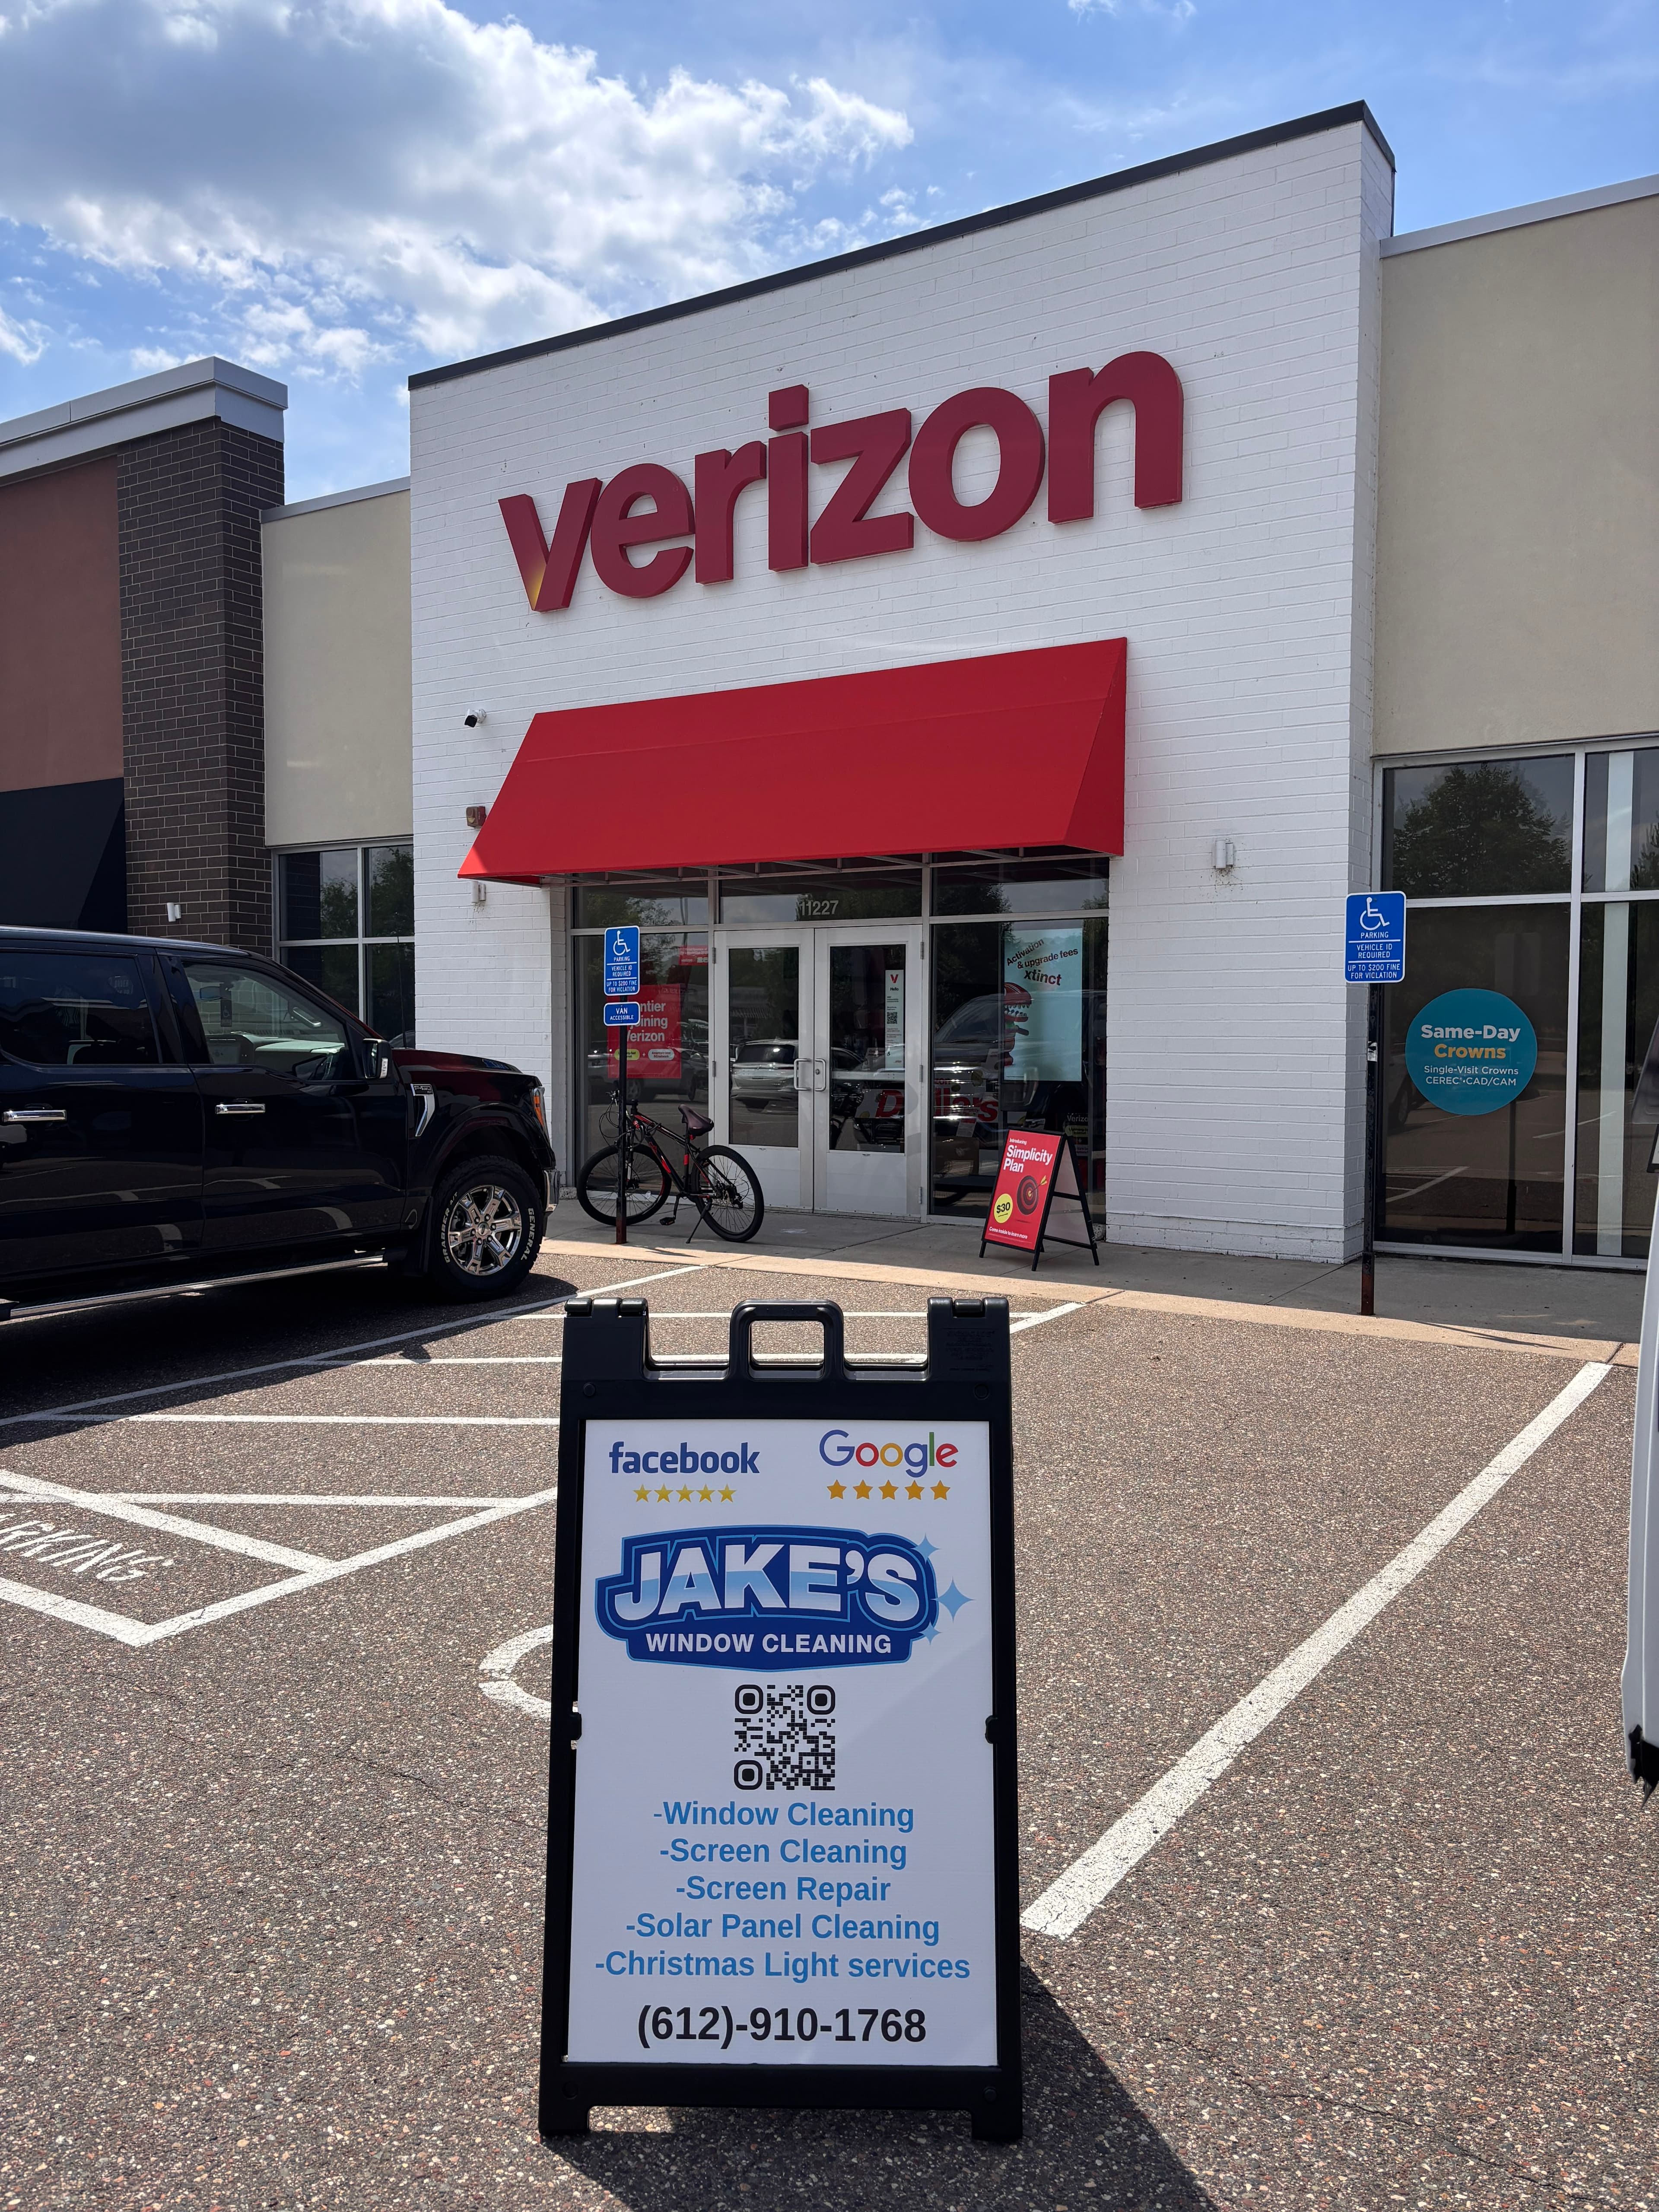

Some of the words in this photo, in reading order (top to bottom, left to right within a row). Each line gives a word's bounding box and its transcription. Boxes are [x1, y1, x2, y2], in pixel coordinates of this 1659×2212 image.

[498, 350, 1184, 612] verizon
[799, 900, 839, 915] 11227
[1007, 939, 1044, 966] Activation
[1025, 953, 1058, 968] upgrade
[1060, 949, 1078, 958] fees
[1023, 969, 1062, 985] xtinct
[640, 1000, 666, 1012] ntier
[630, 1015, 667, 1029] ining
[1421, 1024, 1521, 1042] Same-Day
[1434, 1044, 1506, 1058] Crowns
[1424, 1065, 1478, 1074] Single-Visit
[1481, 1066, 1519, 1074] Crowns
[1003, 1158, 1024, 1173] Plan
[1007, 1145, 1053, 1165] Simplicity
[997, 1202, 1011, 1214] $30
[441, 1208, 450, 1263] GRABBER
[521, 1208, 536, 1261] GENERAL
[609, 1441, 760, 1474] facebook
[820, 1429, 958, 1478] Google
[0, 1512, 174, 1582] RKING
[615, 1544, 919, 1621] JAKE'S
[645, 1633, 753, 1653] WINDOW
[762, 1633, 891, 1654] CLEANING
[653, 1800, 778, 1825] -Window
[787, 1802, 914, 1833] Cleaning
[660, 1838, 770, 1863] -Screen
[779, 1838, 907, 1870] Cleaning
[676, 1875, 786, 1901] -Screen
[797, 1876, 891, 1907] Repair
[626, 1912, 712, 1938] -Solar
[721, 1913, 801, 1939] Panel
[811, 1913, 939, 1945] Cleaning
[595, 1950, 754, 1976] -Christmas
[765, 1951, 839, 1983] Light
[848, 1954, 970, 1979] services
[637, 2004, 926, 2049] (612)-910-1768
